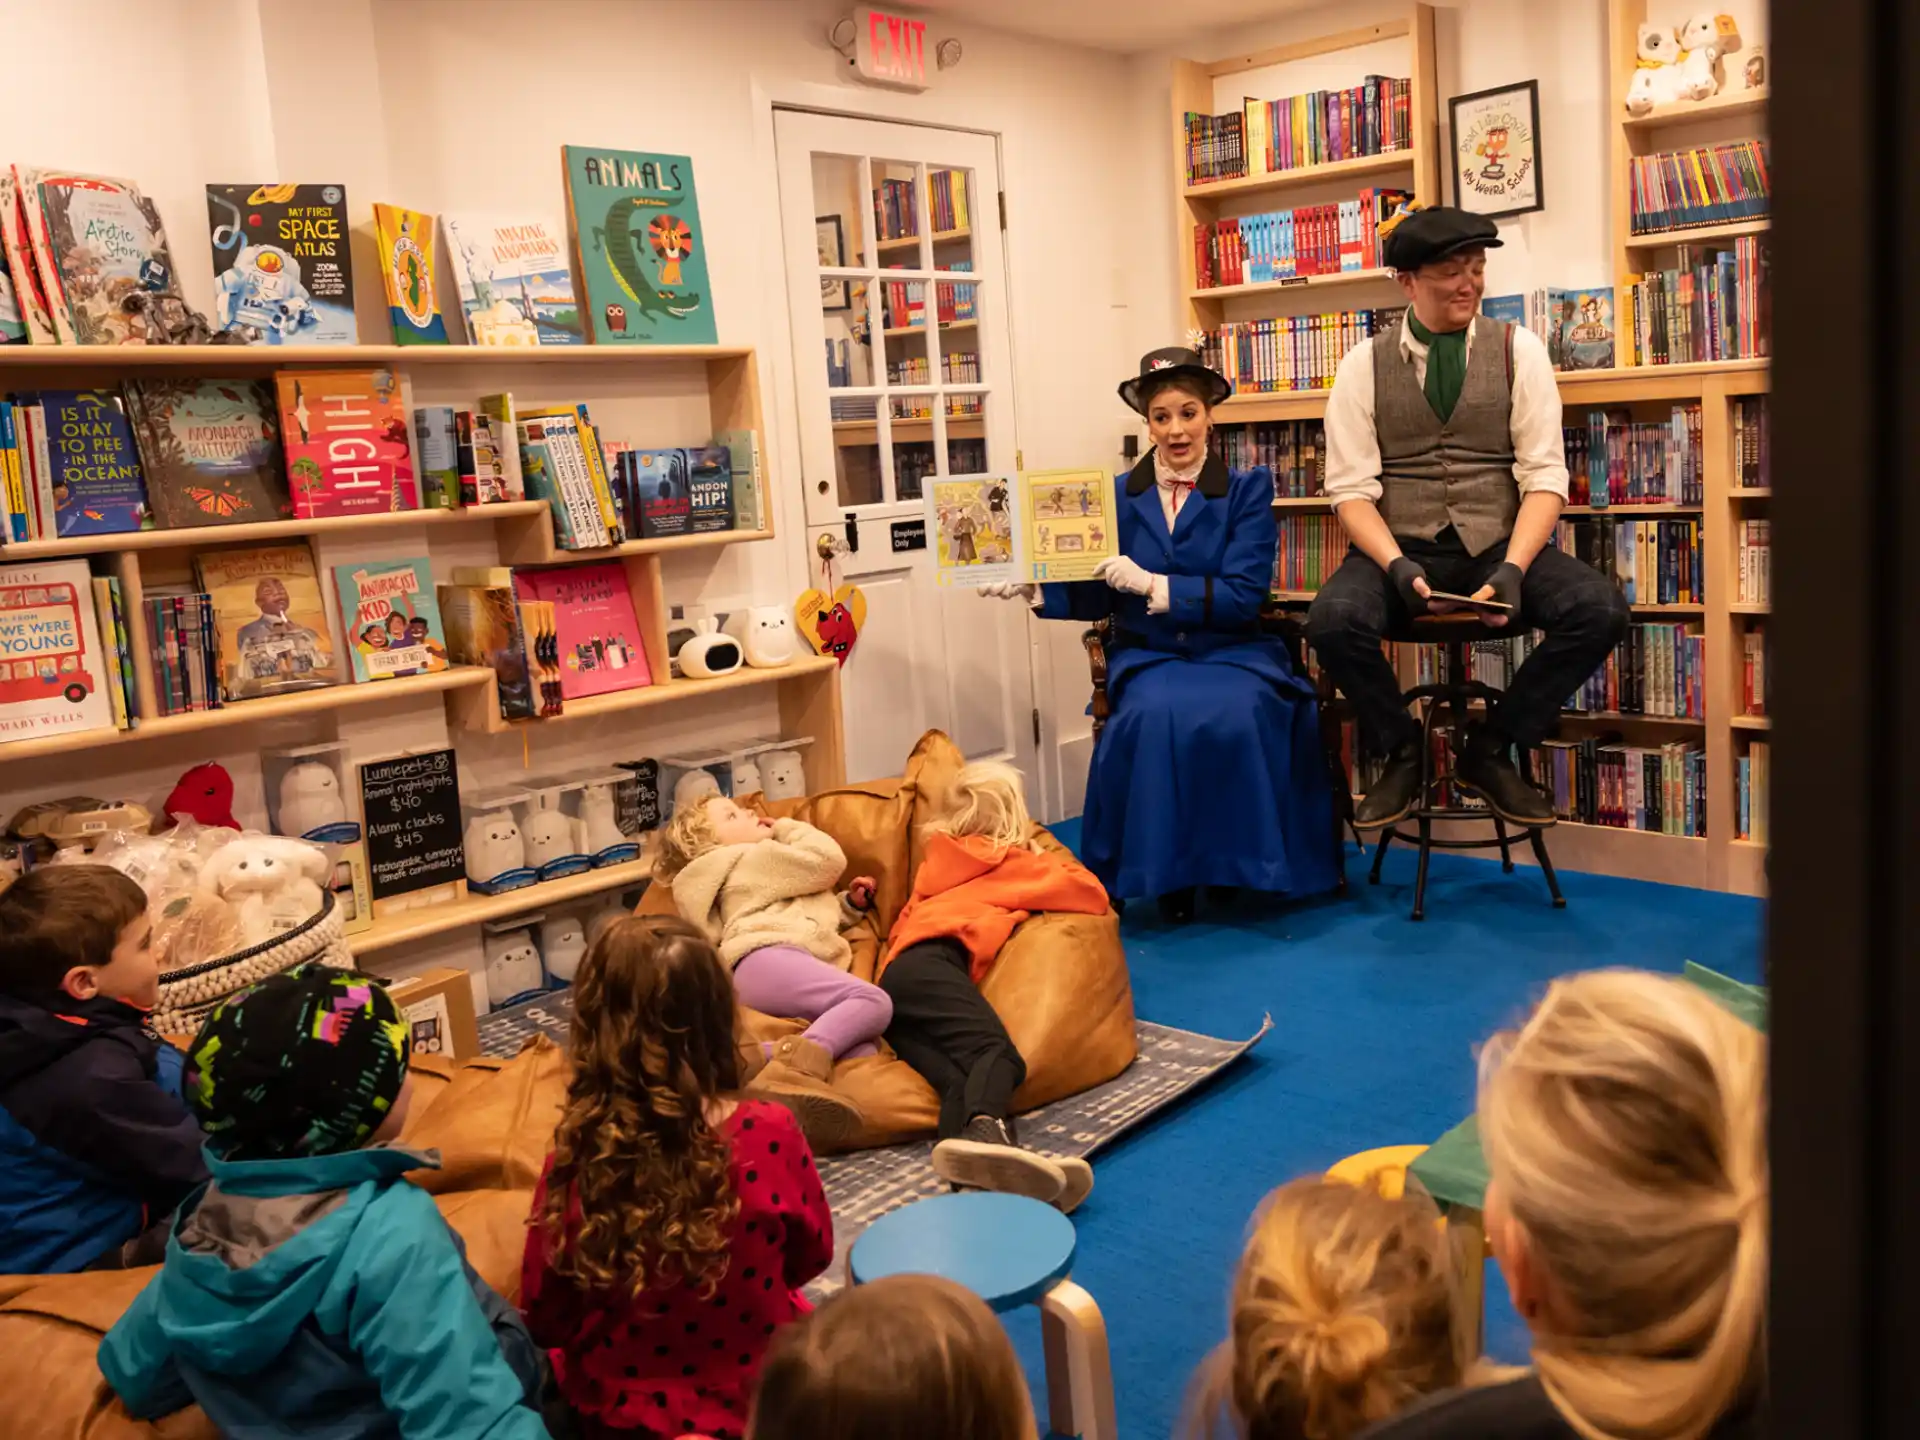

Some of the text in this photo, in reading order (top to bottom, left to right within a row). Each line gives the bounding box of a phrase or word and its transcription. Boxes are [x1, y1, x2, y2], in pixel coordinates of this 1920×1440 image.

[868, 11, 927, 85] EXIT
[585, 157, 682, 190] ANIMALS
[289, 207, 333, 217] MY FIRST
[84, 219, 135, 242] Arctic
[279, 219, 341, 240] SPACE
[494, 223, 546, 243] AMAZING
[294, 241, 336, 257] ATLAS
[492, 239, 559, 264] LANDMARKS
[60, 406, 101, 421] IS IT
[62, 422, 112, 437] OKAY
[57, 437, 123, 453] TO PEE
[321, 394, 381, 490] HIGH
[72, 453, 117, 465] IN THE
[65, 465, 140, 482] OCEAN?
[894, 539, 909, 547] Only
[1033, 563, 1048, 580] H
[360, 572, 416, 598] ANTIRACIST
[361, 599, 391, 622] KID
[0, 620, 71, 637] WE WERE
[0, 633, 75, 653] YOUNG
[41, 711, 84, 725] WELLS
[364, 785, 394, 800] Animal
[389, 796, 422, 813] $40
[368, 813, 445, 838] Alarm clocks
[394, 831, 423, 849] $45
